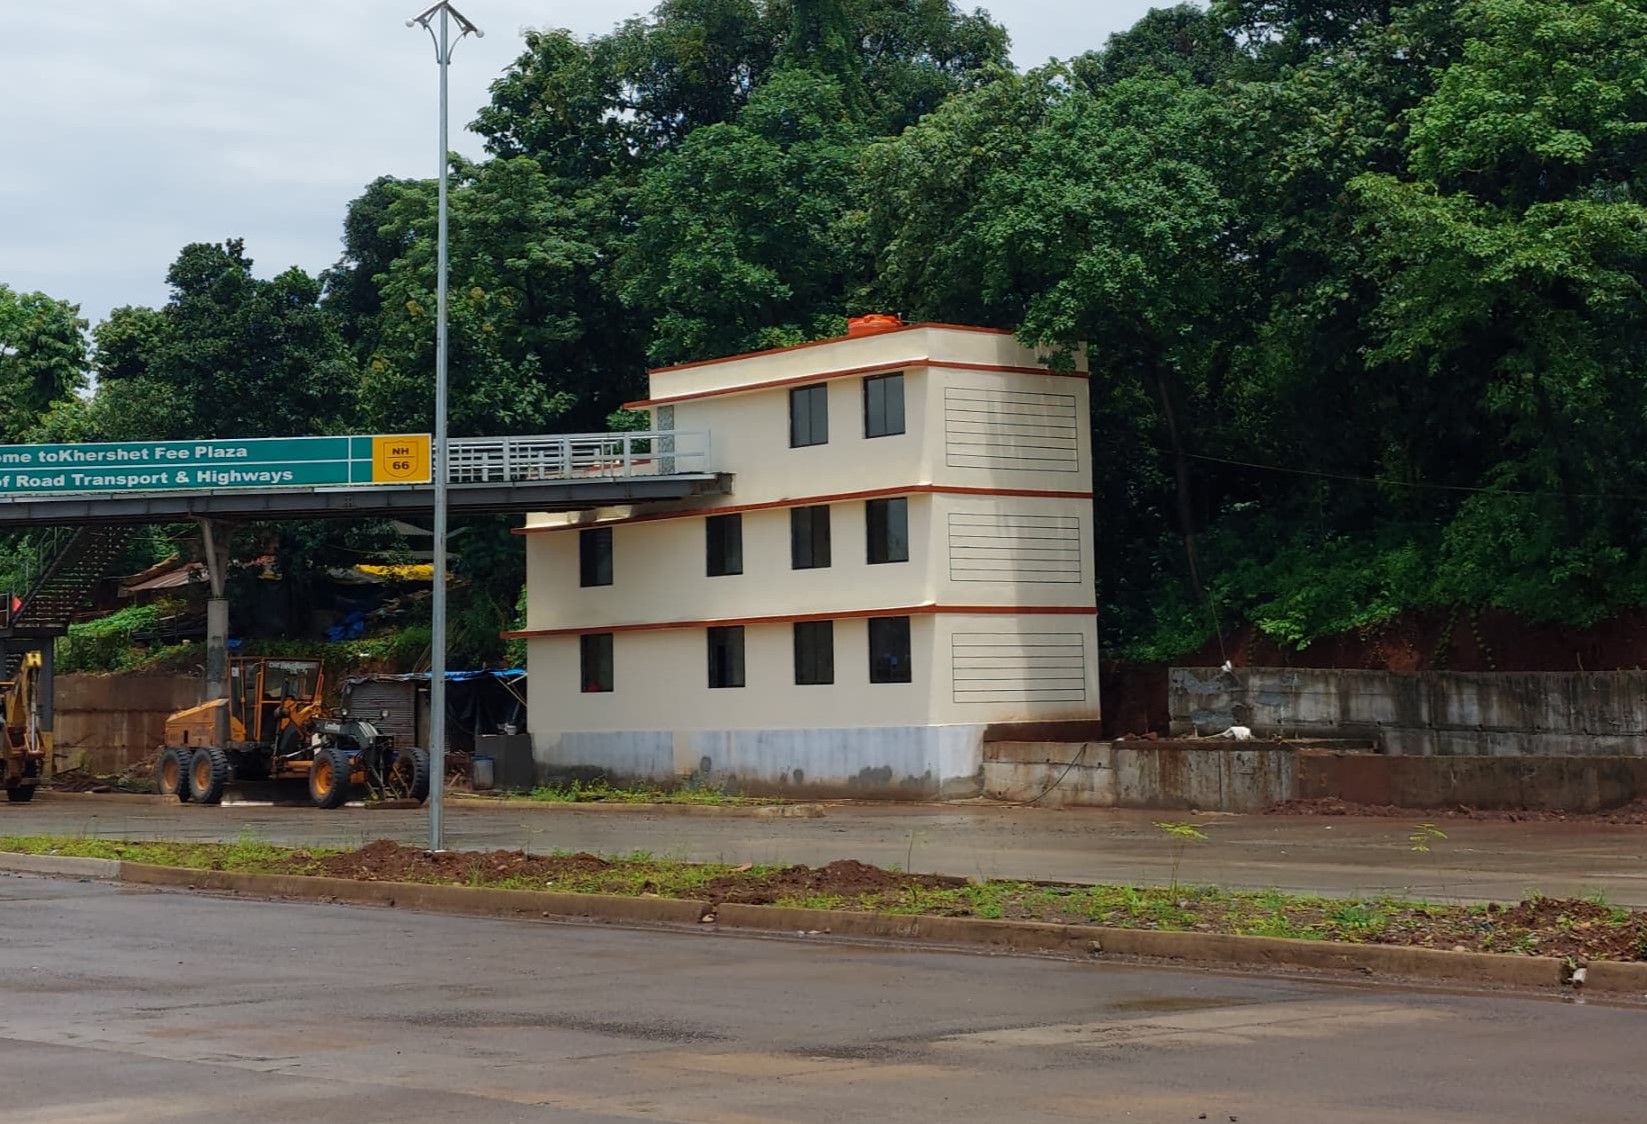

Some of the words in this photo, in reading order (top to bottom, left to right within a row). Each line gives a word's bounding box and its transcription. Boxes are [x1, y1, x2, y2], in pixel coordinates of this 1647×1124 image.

[0, 452, 32, 464] me
[38, 448, 149, 463] toKhershet
[154, 447, 190, 460] Fee
[195, 445, 248, 459] Plaza
[392, 447, 410, 455] NH
[392, 461, 410, 470] 66
[0, 475, 10, 488] f
[16, 474, 65, 487] Road
[71, 471, 168, 488] Transport
[175, 470, 190, 484] &
[197, 469, 293, 485] Highways
